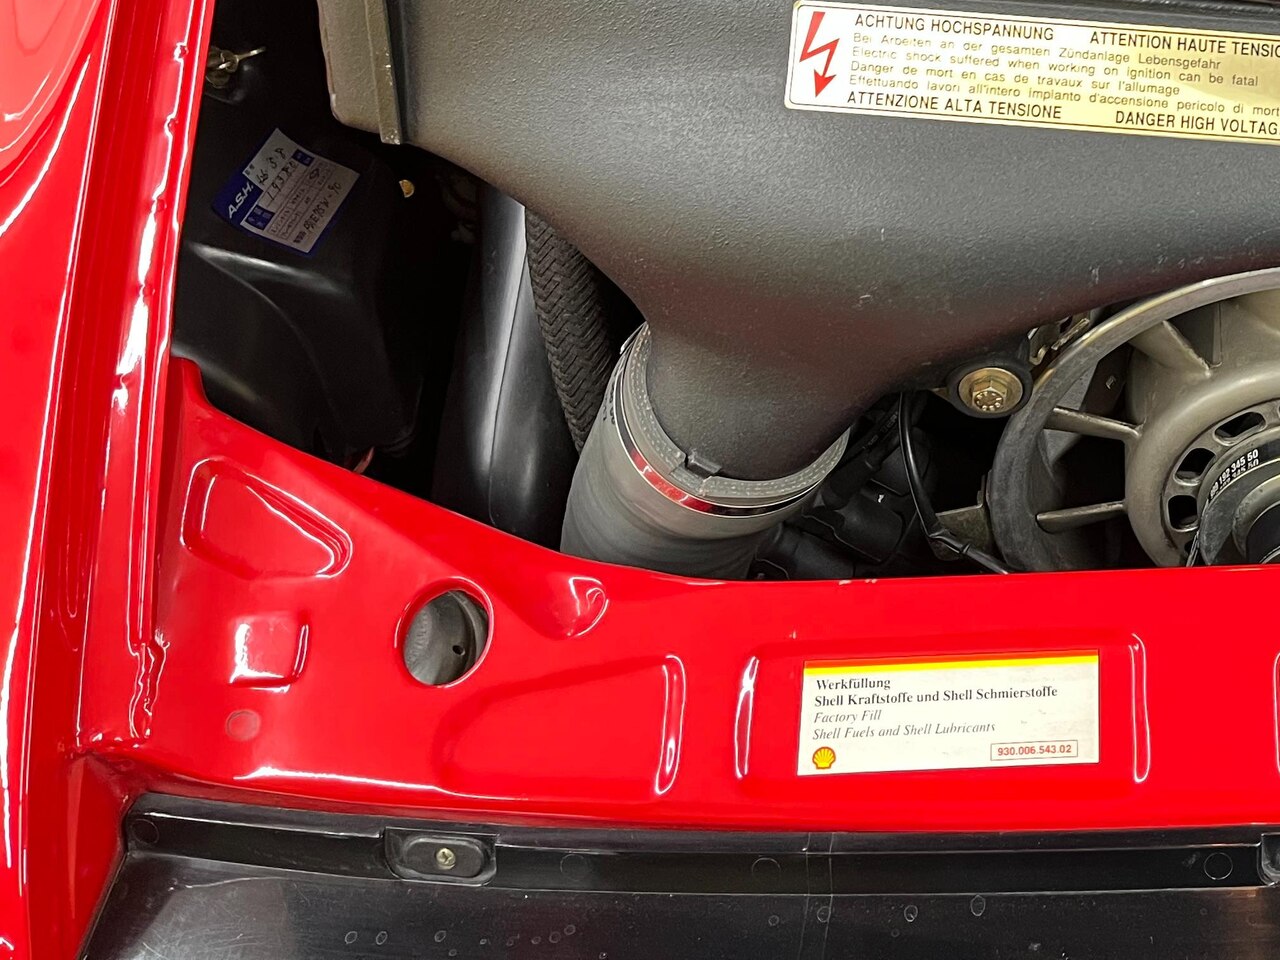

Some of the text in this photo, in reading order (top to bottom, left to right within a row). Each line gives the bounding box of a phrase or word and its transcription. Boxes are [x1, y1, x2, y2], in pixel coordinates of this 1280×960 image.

[855, 14, 1054, 41] ACHTUNG HOCHSPANNUNG
[853, 32, 1221, 70] Bei Arbeiten an der gesamten Zündanlage Lebensgefahr
[1090, 31, 1172, 51] ATTENTION
[1177, 37, 1226, 54] HAUTE
[852, 46, 1259, 87] Electric shock suffered when working on ignition can be fatal
[851, 61, 1180, 96] Danger de mort en cas de travaux sur l'allumage
[847, 91, 1062, 119] ATTENZIONE ALTA TENSIONE
[849, 75, 919, 90] Effettuando
[927, 80, 960, 92] lavori
[968, 83, 1021, 98] all'intero
[1028, 86, 1081, 102] impianto
[1089, 93, 1169, 109] d'accensione
[1177, 100, 1225, 113] pericolo
[1233, 103, 1244, 113] di
[1115, 110, 1175, 128] DANGER
[1180, 115, 1215, 131] HIGH
[816, 678, 891, 691] Werkfüllung
[814, 686, 1058, 707] Shell Kraftstoffe und Shell Schmierstoffe
[813, 709, 882, 725] Factory Fill
[812, 722, 996, 741] Shell Fuels and Shell Lubricants
[997, 744, 1073, 757] 930.006.543.02
